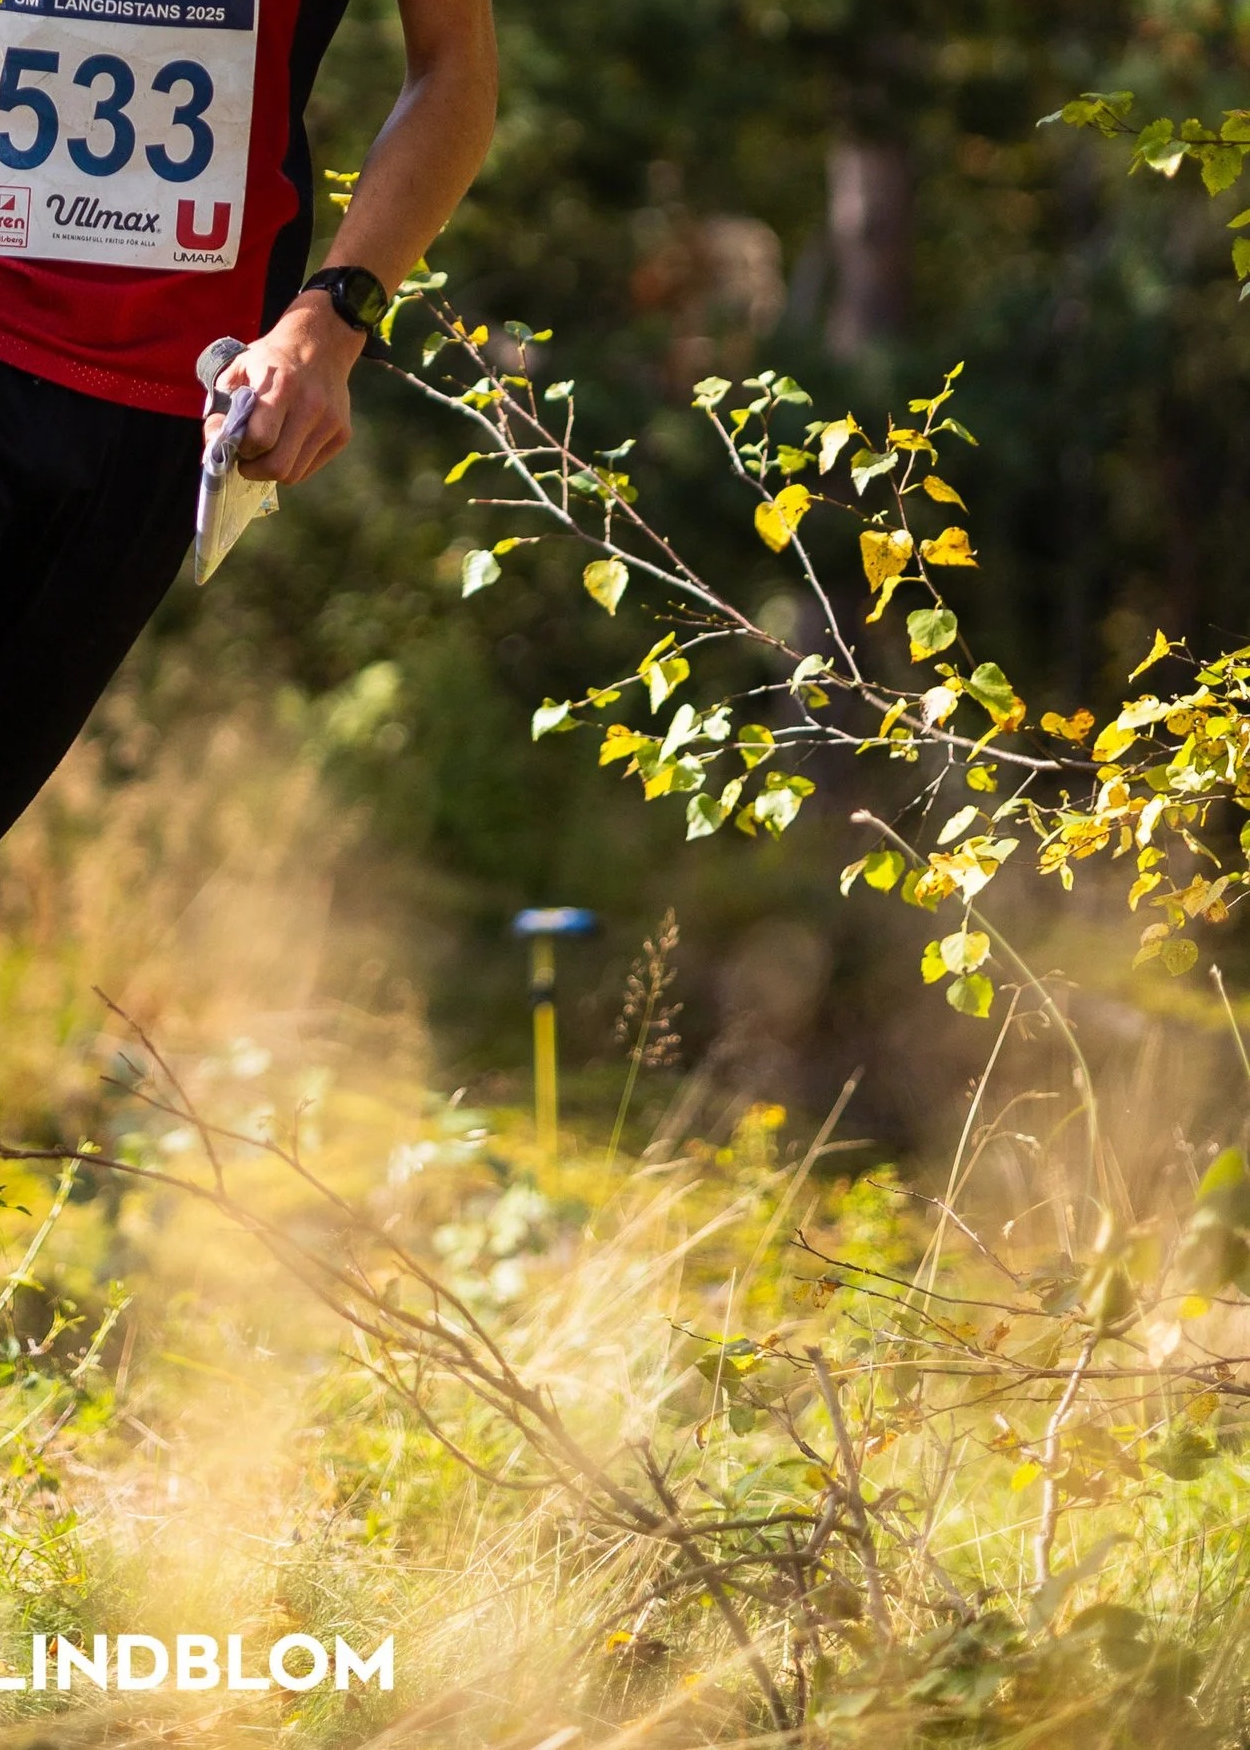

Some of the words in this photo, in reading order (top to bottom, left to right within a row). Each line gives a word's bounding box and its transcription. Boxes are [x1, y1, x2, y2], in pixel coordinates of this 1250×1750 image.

[185, 5, 226, 22] 2025
[46, 193, 161, 234] Ullmax
[52, 232, 61, 240] EN
[173, 251, 224, 264] UMARA
